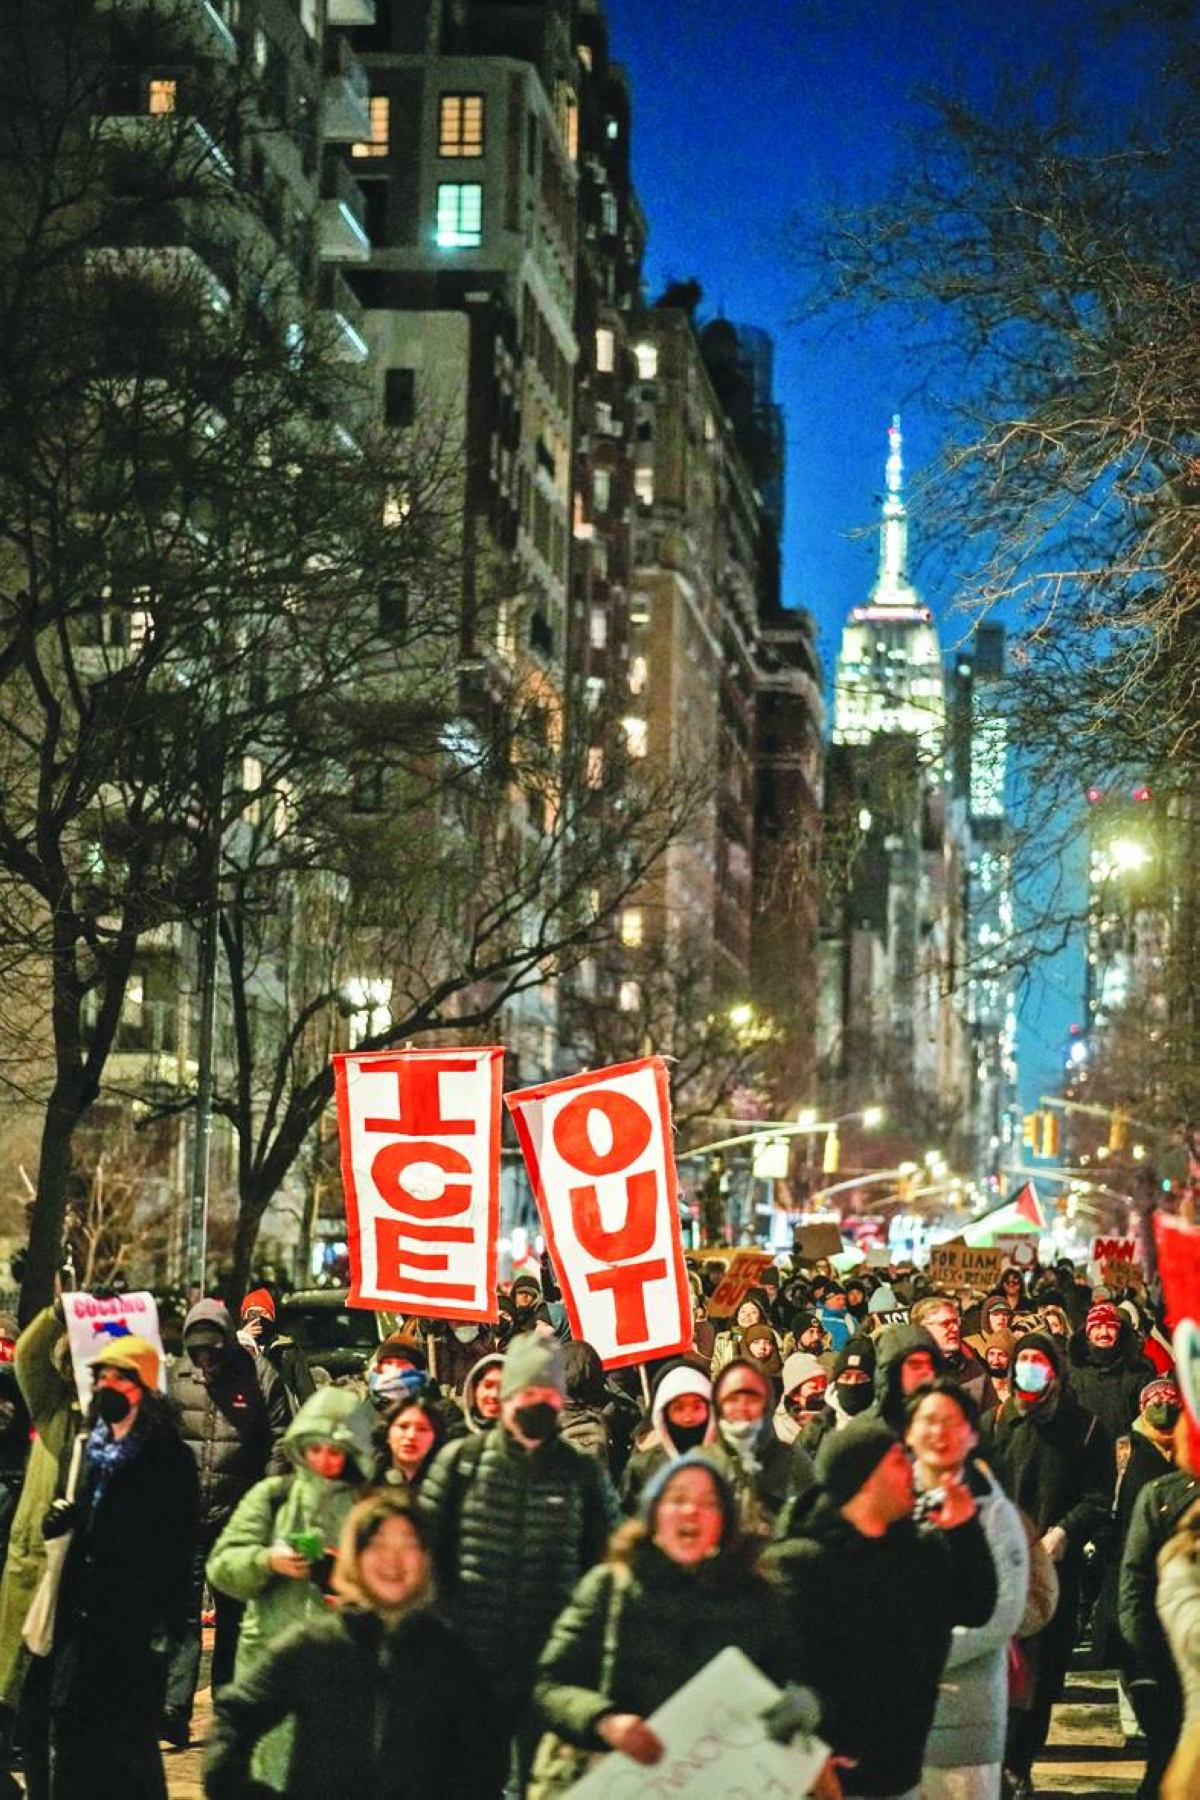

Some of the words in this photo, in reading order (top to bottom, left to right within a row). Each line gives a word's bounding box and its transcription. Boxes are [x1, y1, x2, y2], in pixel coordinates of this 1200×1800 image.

[359, 1059, 477, 1302] ICE
[552, 1089, 667, 1346] OUT
[931, 1249, 956, 1267] FOR
[962, 1252, 997, 1269] LIAM
